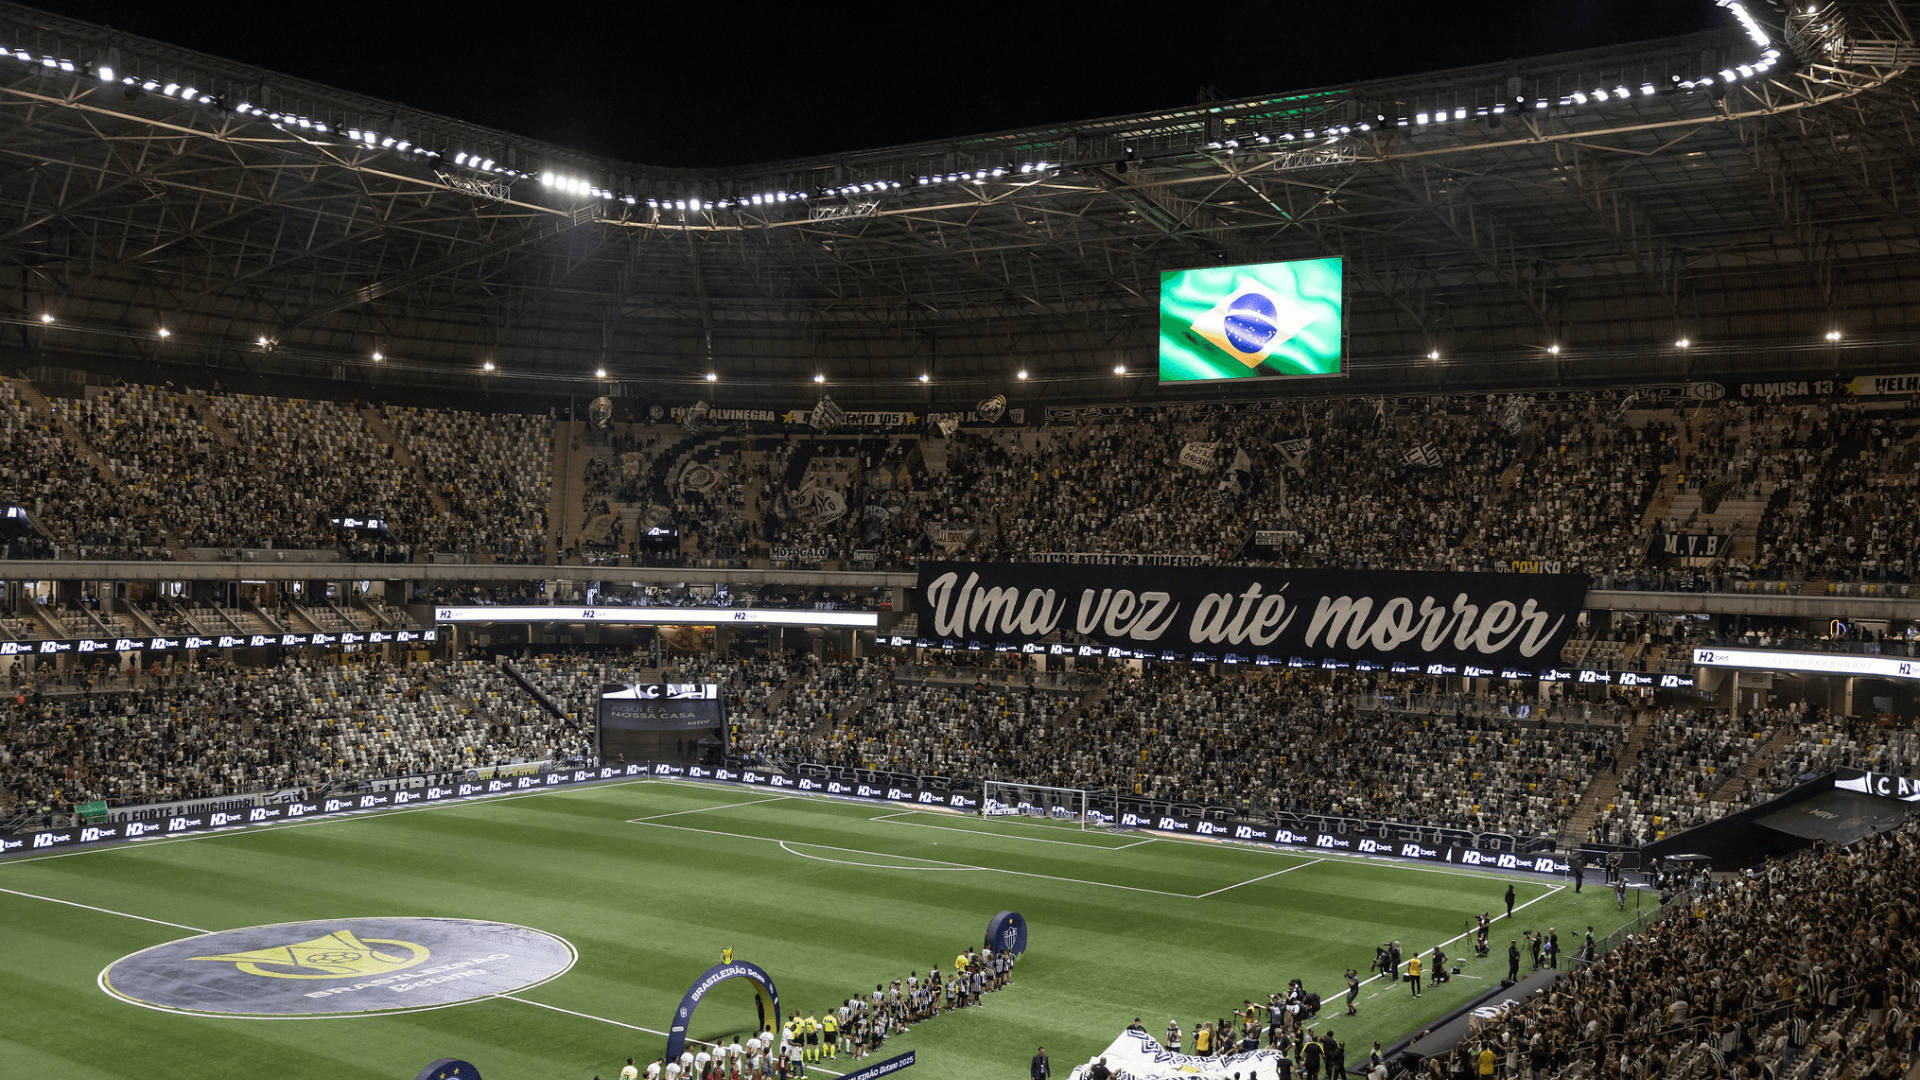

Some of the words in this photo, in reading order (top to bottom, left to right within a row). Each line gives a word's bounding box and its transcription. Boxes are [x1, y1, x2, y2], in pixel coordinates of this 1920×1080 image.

[1740, 381, 1809, 398] CAMISA
[1875, 376, 1920, 392] VELH
[709, 408, 775, 421] ALVINEGRA
[878, 413, 899, 425] 105
[771, 548, 827, 557] MOTOGALO
[928, 571, 1067, 639] Uma
[1076, 588, 1181, 641] vez
[1188, 581, 1298, 647] até
[1304, 592, 1566, 659] morrer
[611, 705, 643, 713] AQUI
[611, 711, 657, 719] NOSSA
[33, 833, 70, 847] H2bet
[80, 828, 116, 842] H2bet
[126, 822, 159, 836] H2bet
[169, 818, 201, 831] H2bet
[210, 813, 241, 826] H2bet
[250, 808, 280, 821] H2bet
[288, 804, 317, 816] H2bet
[325, 799, 352, 811] H2bet
[360, 795, 387, 807] H2bet
[395, 791, 420, 803] H2bet
[427, 788, 452, 799] H2bet
[459, 784, 482, 795] H2bet
[489, 781, 512, 791] H2bet
[518, 777, 540, 788] H2bet
[547, 774, 568, 784] H2bet
[574, 771, 595, 781] H2bet
[600, 768, 621, 778] H2bet
[626, 765, 647, 775] H2bet
[689, 767, 710, 776] H2bet
[716, 769, 737, 779] H2bet
[743, 772, 765, 782] H2bet
[771, 775, 793, 786] H2bet
[799, 779, 821, 789] H2bet
[828, 782, 851, 793] H2bet
[857, 785, 881, 796] H2bet
[887, 789, 912, 799] H2bet
[918, 792, 944, 803] H2bet
[951, 795, 976, 806] H2bet
[1122, 814, 1150, 825] H2bet
[1159, 818, 1188, 829] H2bet
[1197, 821, 1227, 834] H2bet
[1235, 826, 1266, 838] H2bet
[1275, 830, 1307, 843] H2bet
[1316, 835, 1349, 847] H2bet
[1359, 839, 1392, 852] H2bet
[1402, 844, 1436, 857] H2bet
[1462, 850, 1496, 864] H2bet
[1498, 854, 1532, 868] H2bet
[303, 954, 511, 998] BRASILEIRÃO
[389, 968, 487, 993] Betano
[691, 965, 746, 1002] BRASILEIRÃO
[899, 1055, 914, 1067] 2025
